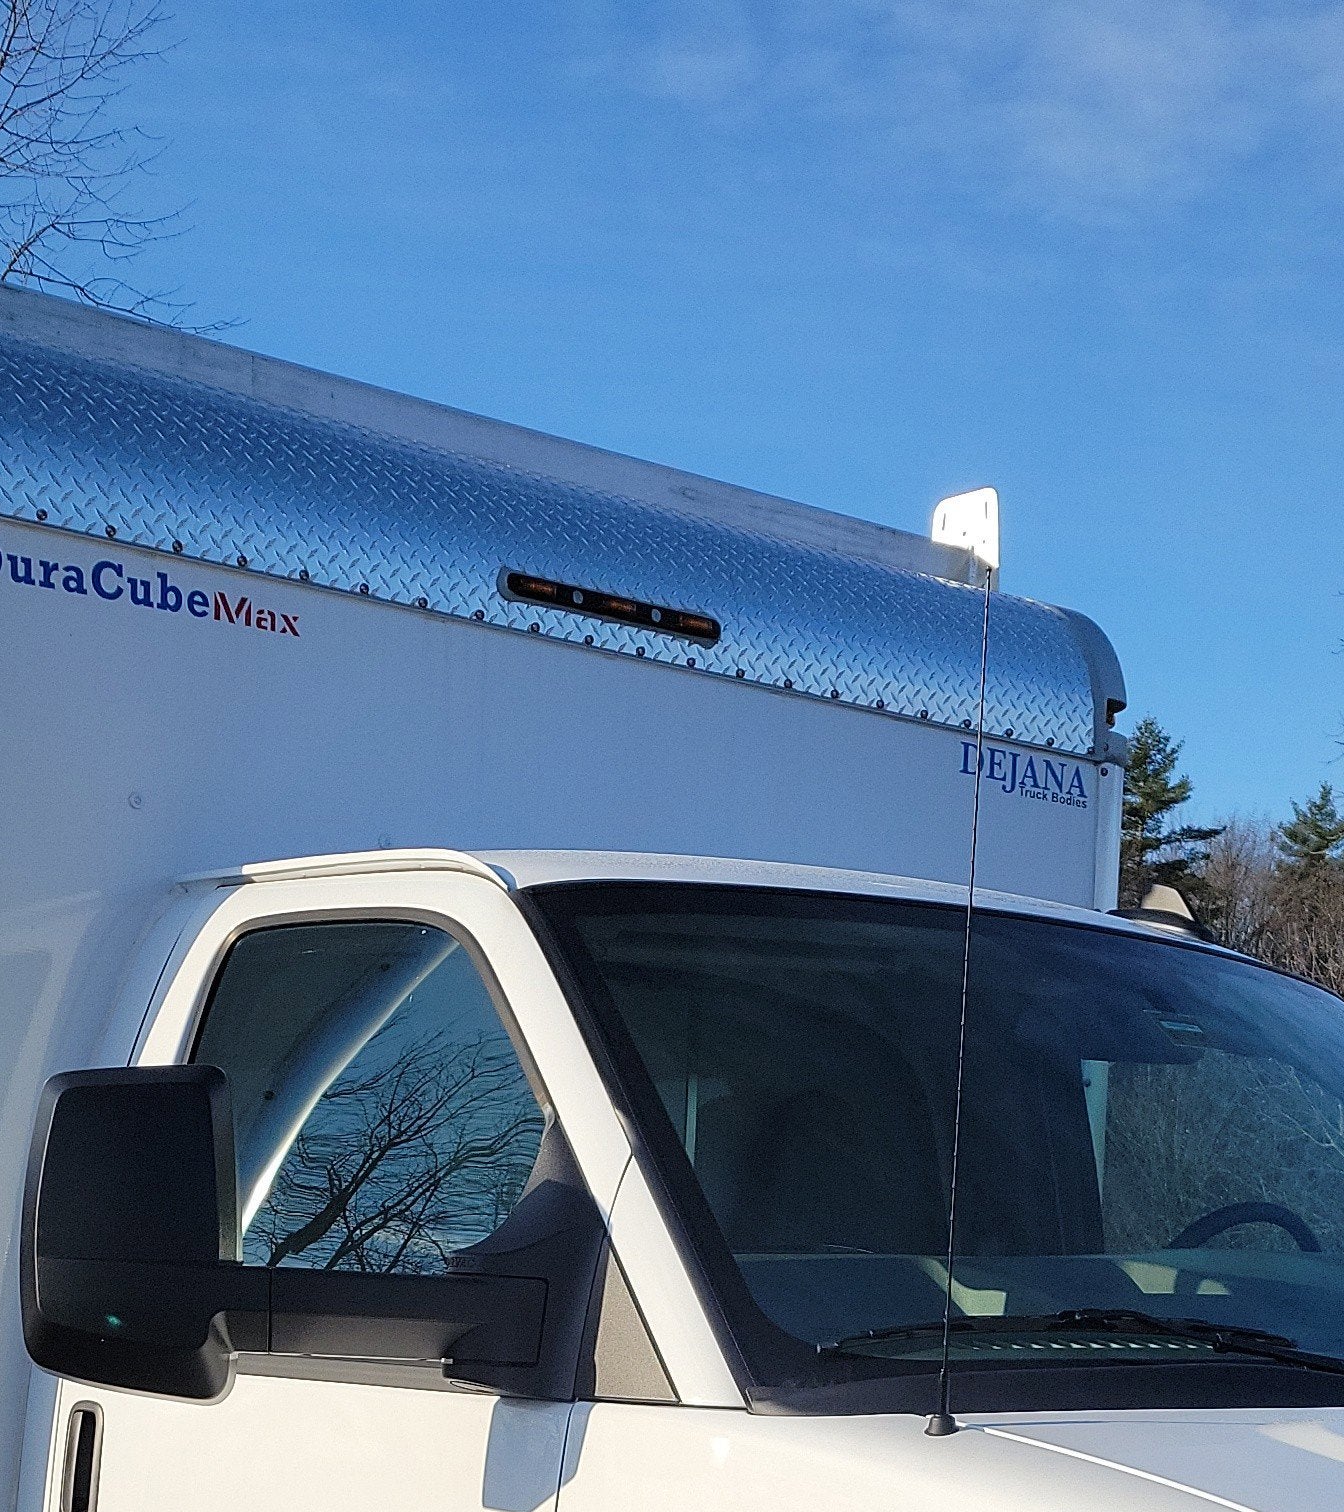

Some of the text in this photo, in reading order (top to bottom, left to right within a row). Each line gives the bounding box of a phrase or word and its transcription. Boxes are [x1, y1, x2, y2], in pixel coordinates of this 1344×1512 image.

[958, 740, 1088, 799] DEJANA
[1018, 785, 1088, 810] Truck Bodies
